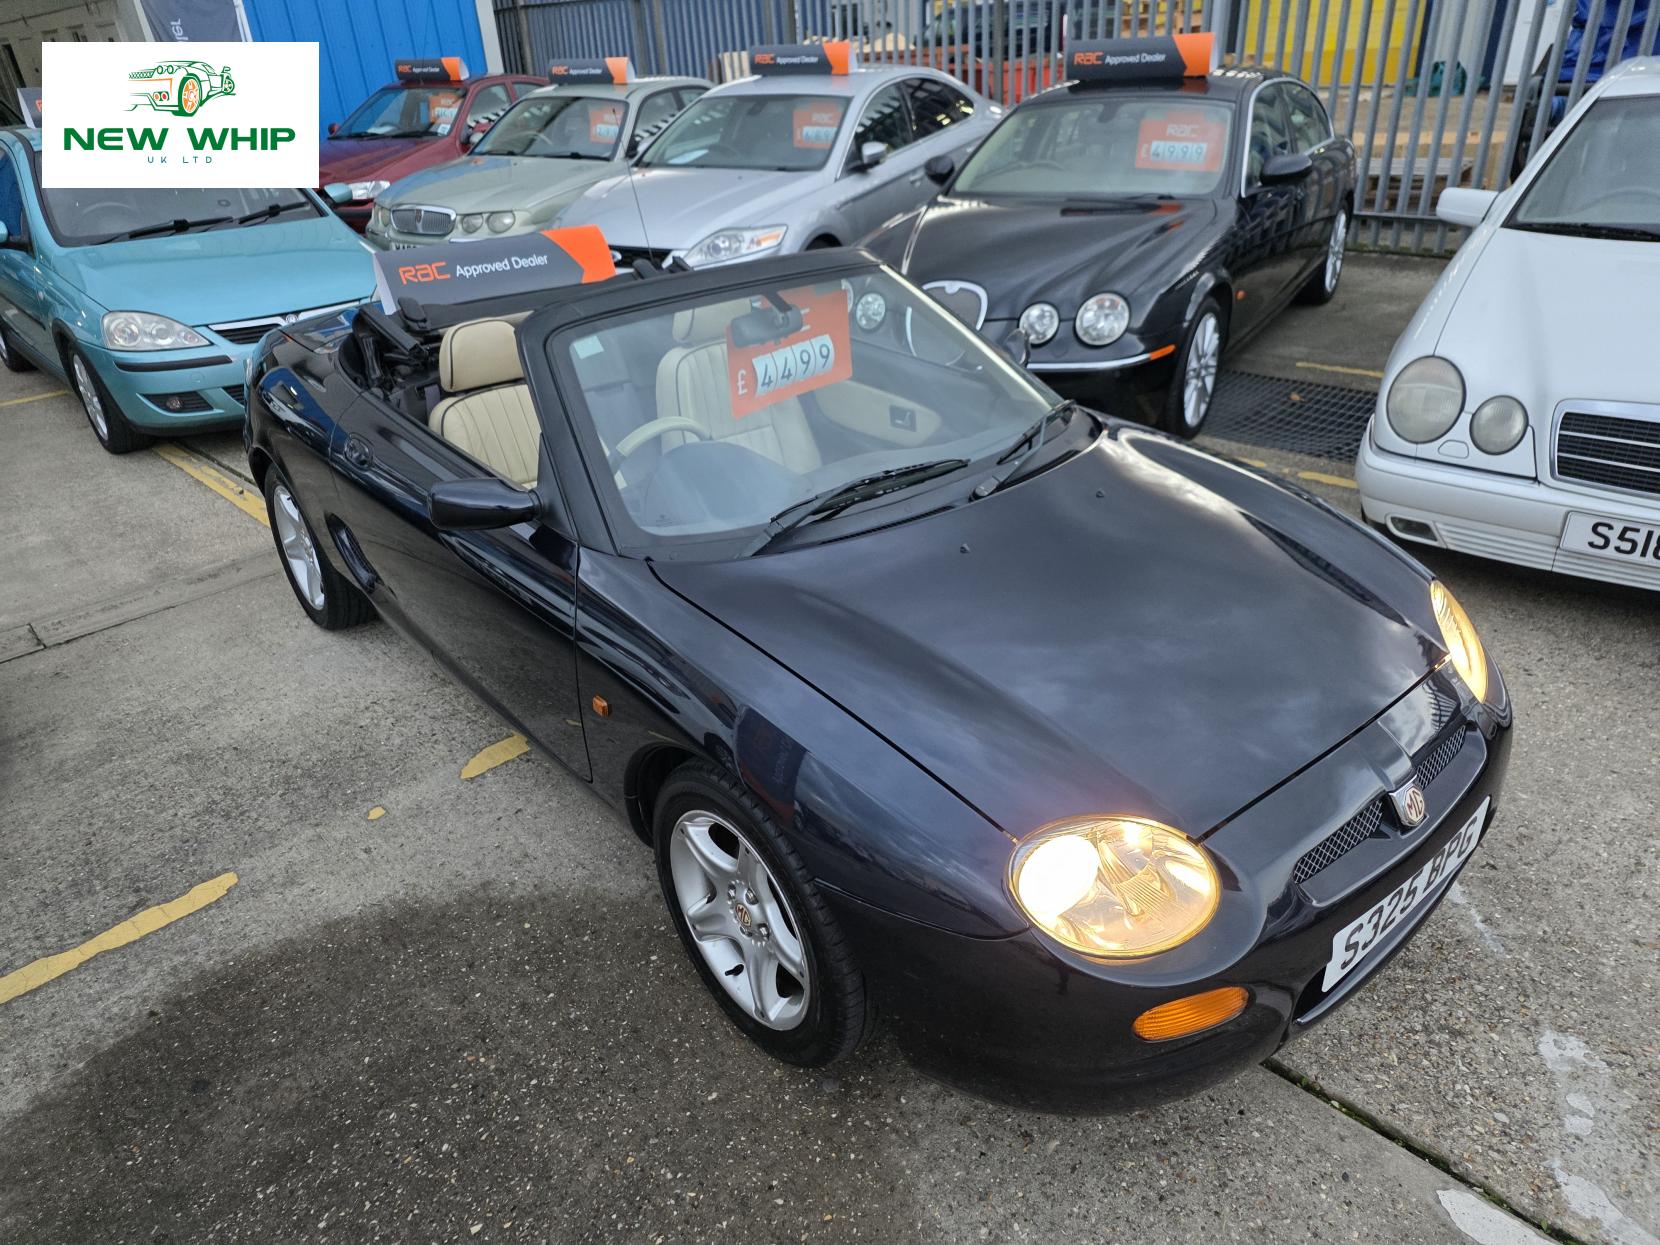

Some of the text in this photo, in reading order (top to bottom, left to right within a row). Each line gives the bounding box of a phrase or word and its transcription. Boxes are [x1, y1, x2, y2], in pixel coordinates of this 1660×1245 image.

[1104, 54, 1139, 65] Approved
[1140, 52, 1166, 63] Dealer
[399, 254, 547, 285] RAC Approved Dealer
[760, 343, 831, 388] 4499
[1588, 521, 1660, 560] S51
[1406, 789, 1424, 818] MG
[1341, 816, 1477, 970] S325 BPG
[736, 906, 750, 925] MG
